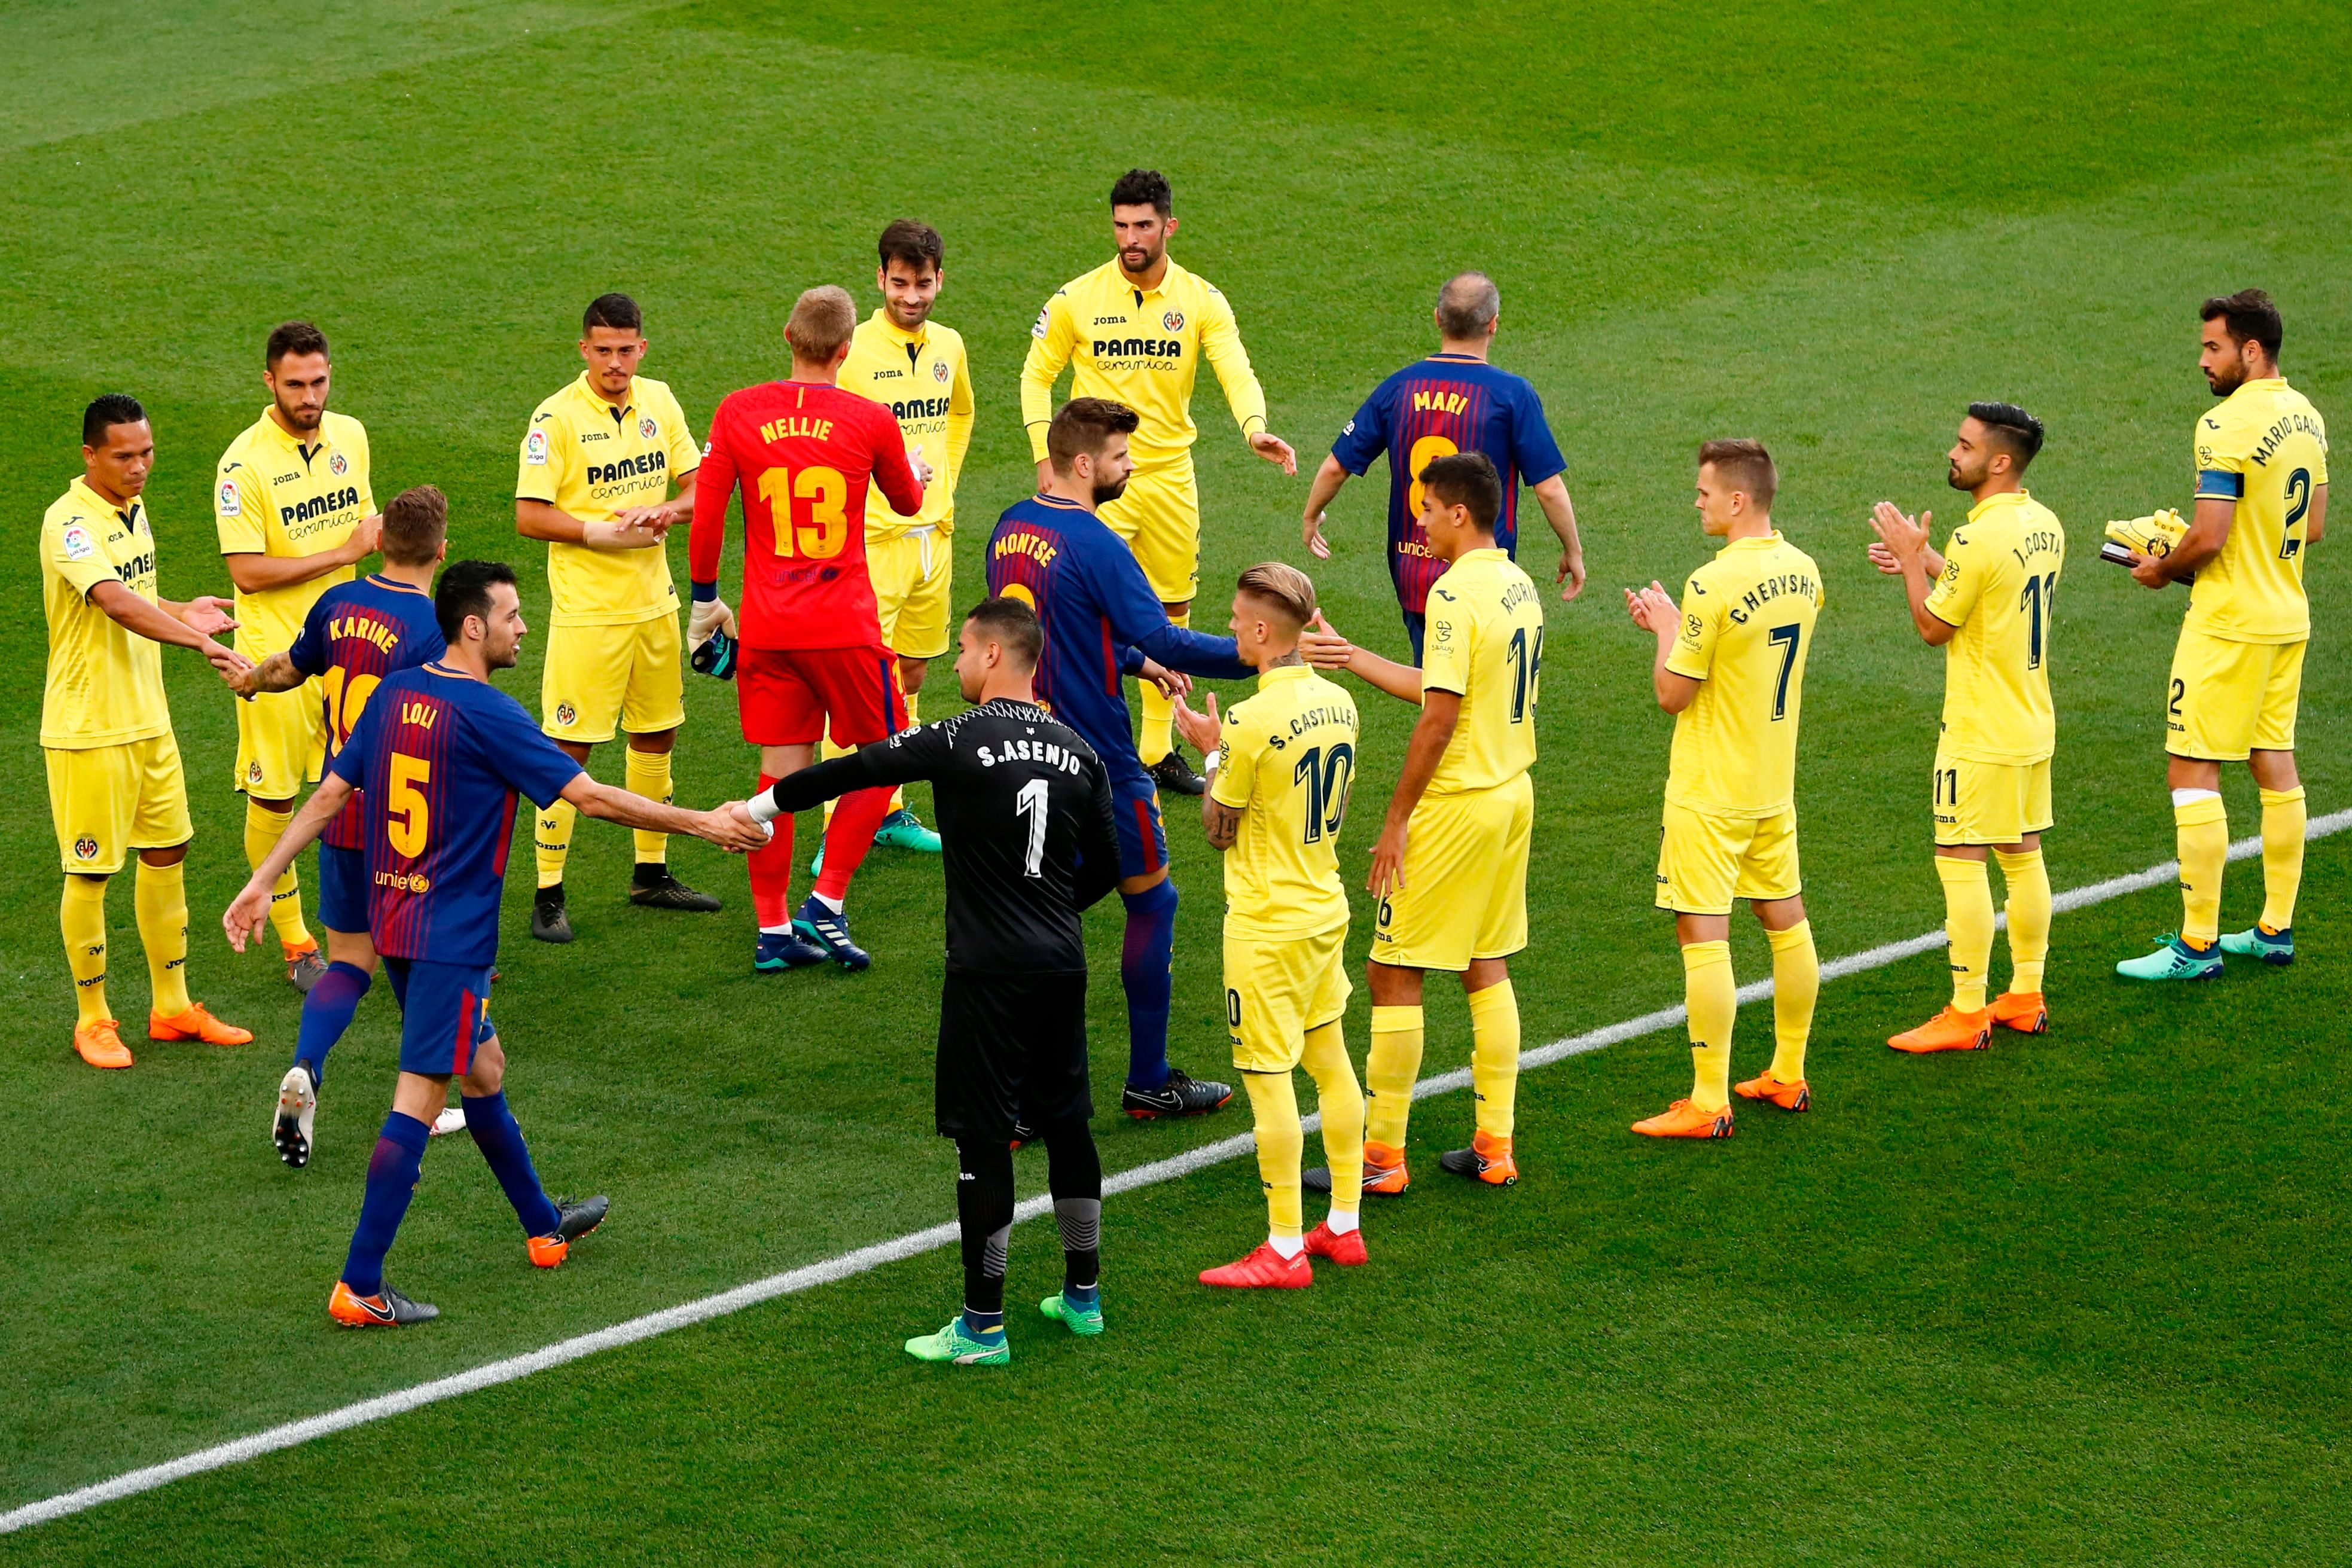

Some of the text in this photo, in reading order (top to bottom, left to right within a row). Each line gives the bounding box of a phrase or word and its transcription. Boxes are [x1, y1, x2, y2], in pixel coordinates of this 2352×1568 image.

[1033, 325, 1044, 334] Liga
[1093, 338, 1181, 357] PAMESA
[1097, 358, 1177, 371] ceramica
[1413, 391, 1468, 416] MARI
[759, 417, 834, 444] NELLIE
[899, 420, 946, 435] ramica
[2252, 414, 2326, 467] MARIO GASPA
[587, 450, 665, 484] PAMESA
[591, 475, 665, 499] ceramica
[280, 486, 359, 526] PAMESA
[757, 466, 848, 559] 13
[2278, 468, 2310, 559] 2
[288, 511, 359, 540] ceramica
[70, 546, 90, 557] LaLiga
[114, 550, 157, 581] PAMES
[995, 532, 1057, 568] MONTSE
[1398, 541, 1436, 558] unice
[2013, 532, 2060, 569] J.COSTA
[774, 566, 818, 583] unicef
[330, 617, 399, 655] KARINE
[2021, 571, 2056, 670] 11
[1507, 626, 1543, 724] 16
[1768, 623, 1800, 721] 7
[323, 665, 383, 758] 10
[402, 702, 438, 730] LOLI
[2170, 678, 2185, 717] 2
[977, 739, 1081, 776] S.ASENJO
[388, 752, 431, 859] 5
[1294, 743, 1353, 844] 10
[1935, 768, 1957, 807] 11
[1017, 779, 1048, 878] 1
[1378, 892, 1392, 928] 6
[1227, 988, 1241, 1029] 0
